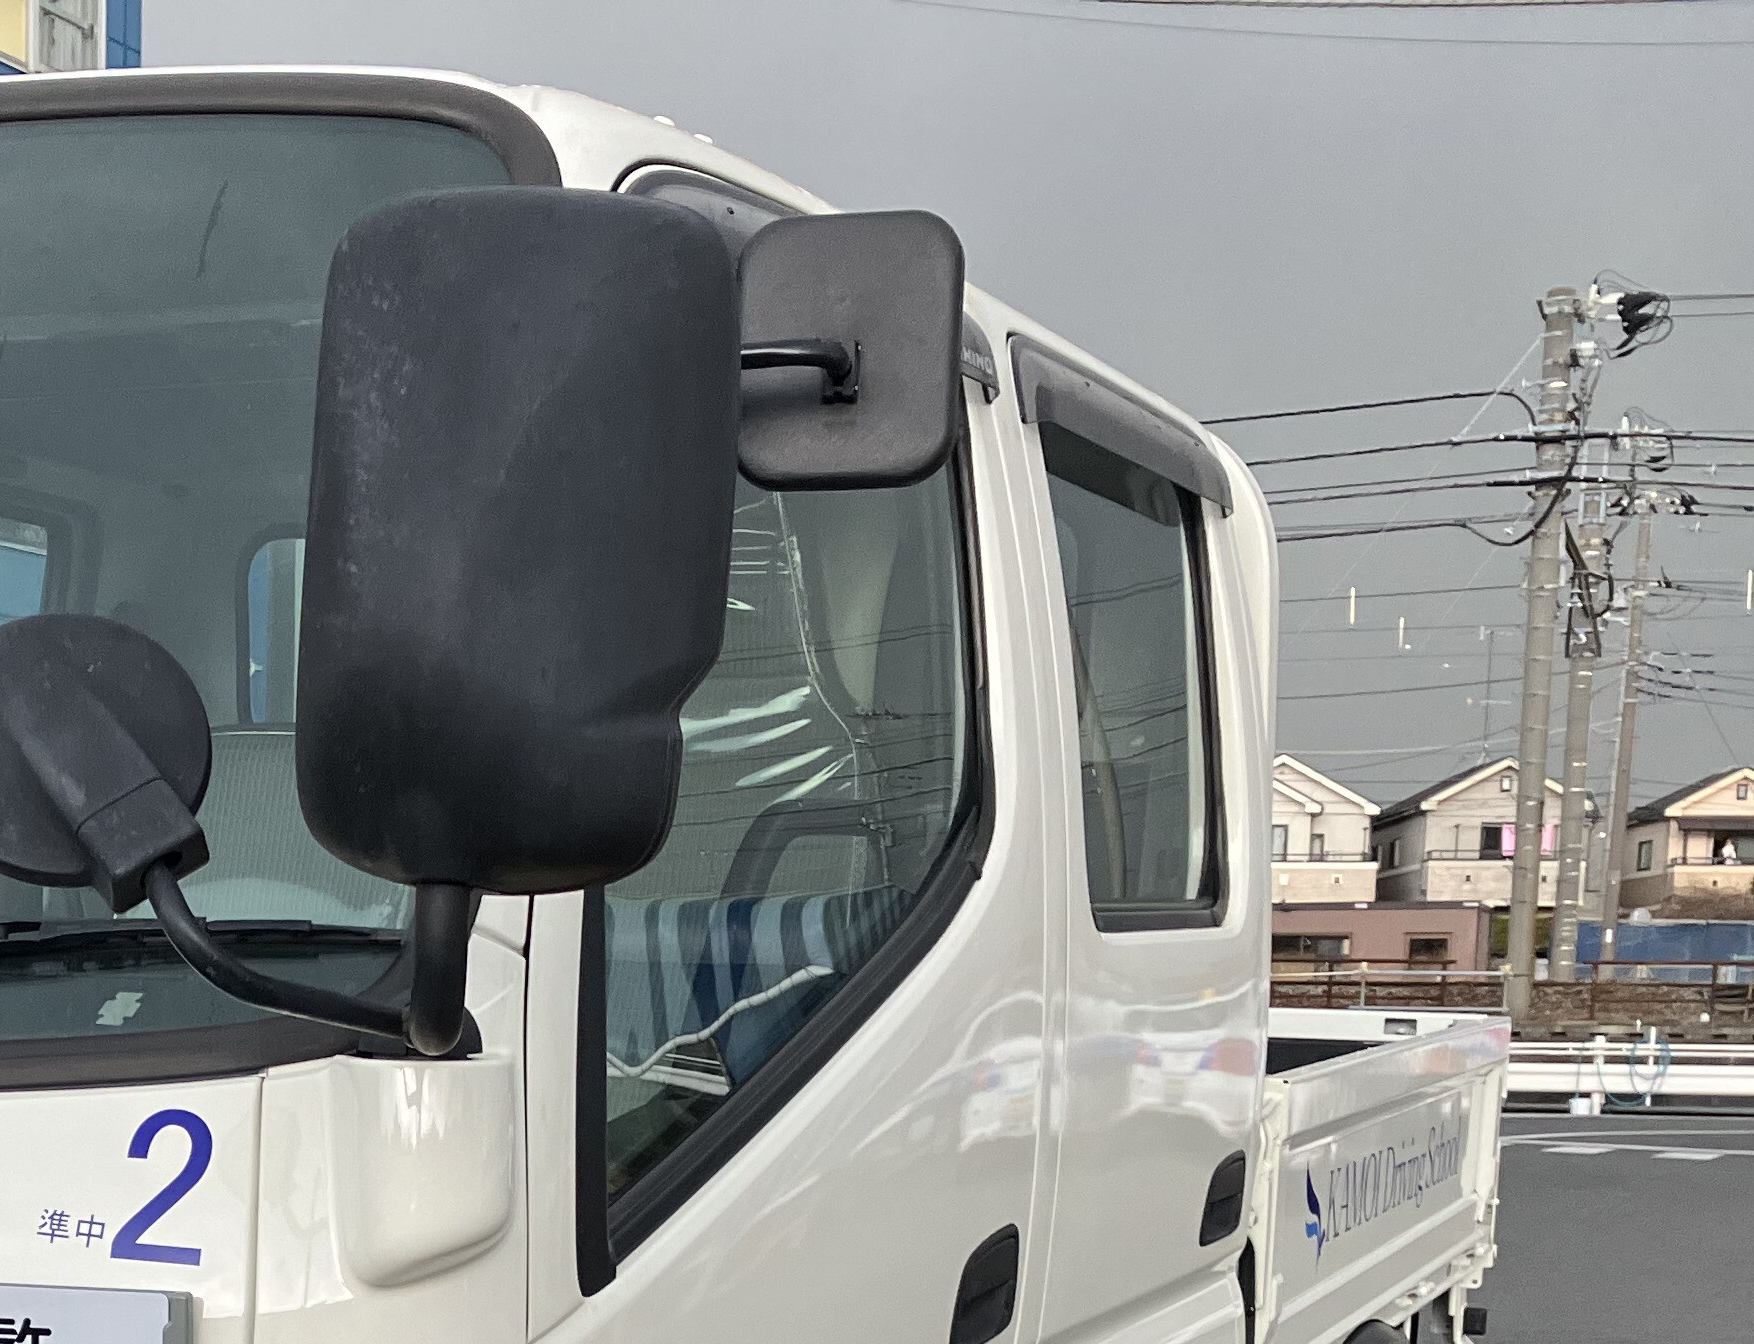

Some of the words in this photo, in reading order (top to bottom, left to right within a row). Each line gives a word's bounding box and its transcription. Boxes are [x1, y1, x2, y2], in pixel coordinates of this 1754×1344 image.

[36, 1208, 106, 1249] 準中
[110, 1108, 214, 1266] 2
[1326, 1150, 1383, 1242] KAMOI
[1382, 1136, 1427, 1213] Driving
